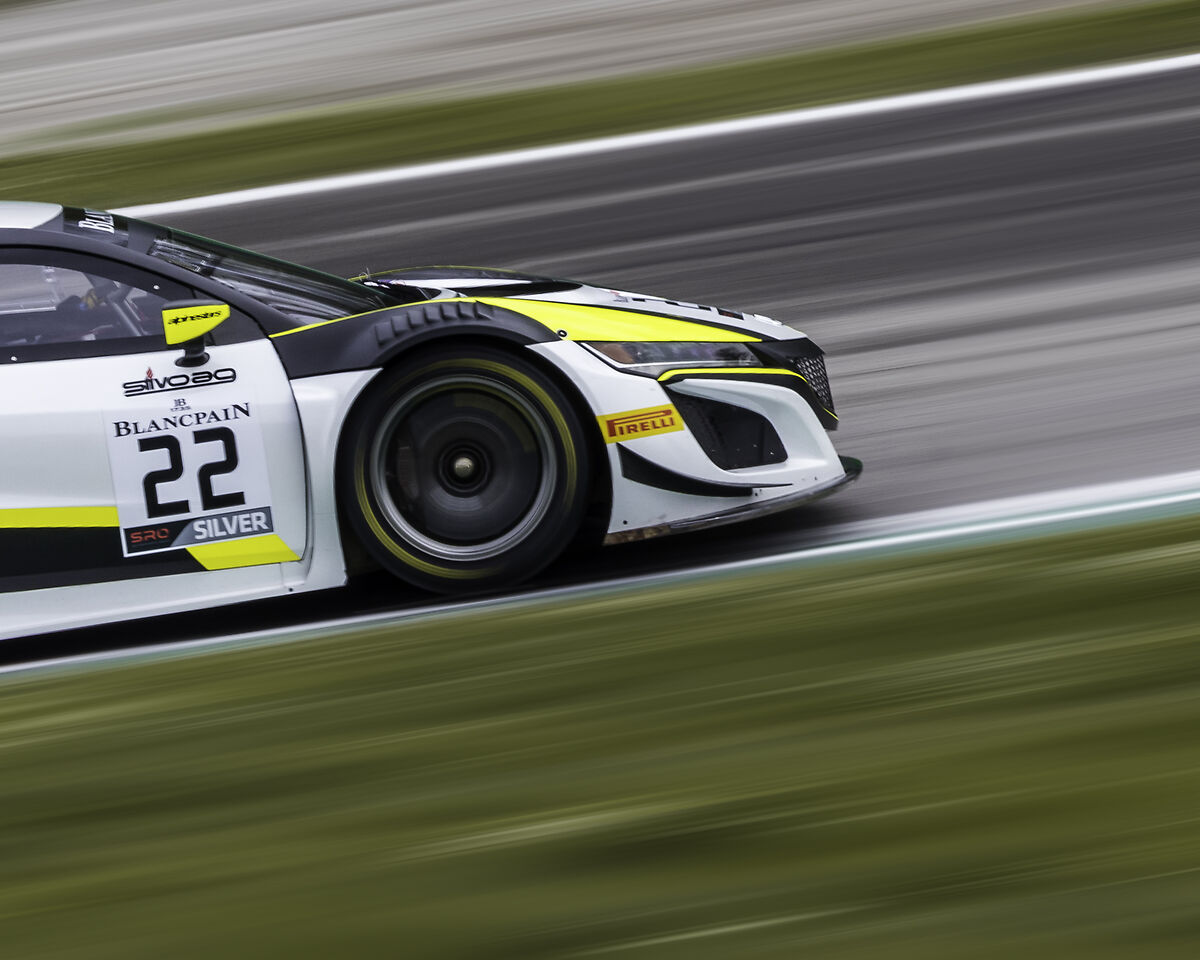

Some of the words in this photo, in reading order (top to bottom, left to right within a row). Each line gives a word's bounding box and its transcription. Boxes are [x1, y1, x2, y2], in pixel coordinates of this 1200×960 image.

[113, 402, 251, 438] BLANCPAIN
[606, 409, 675, 437] PIRELLI
[137, 426, 246, 519] 22
[193, 511, 269, 540] SILVER
